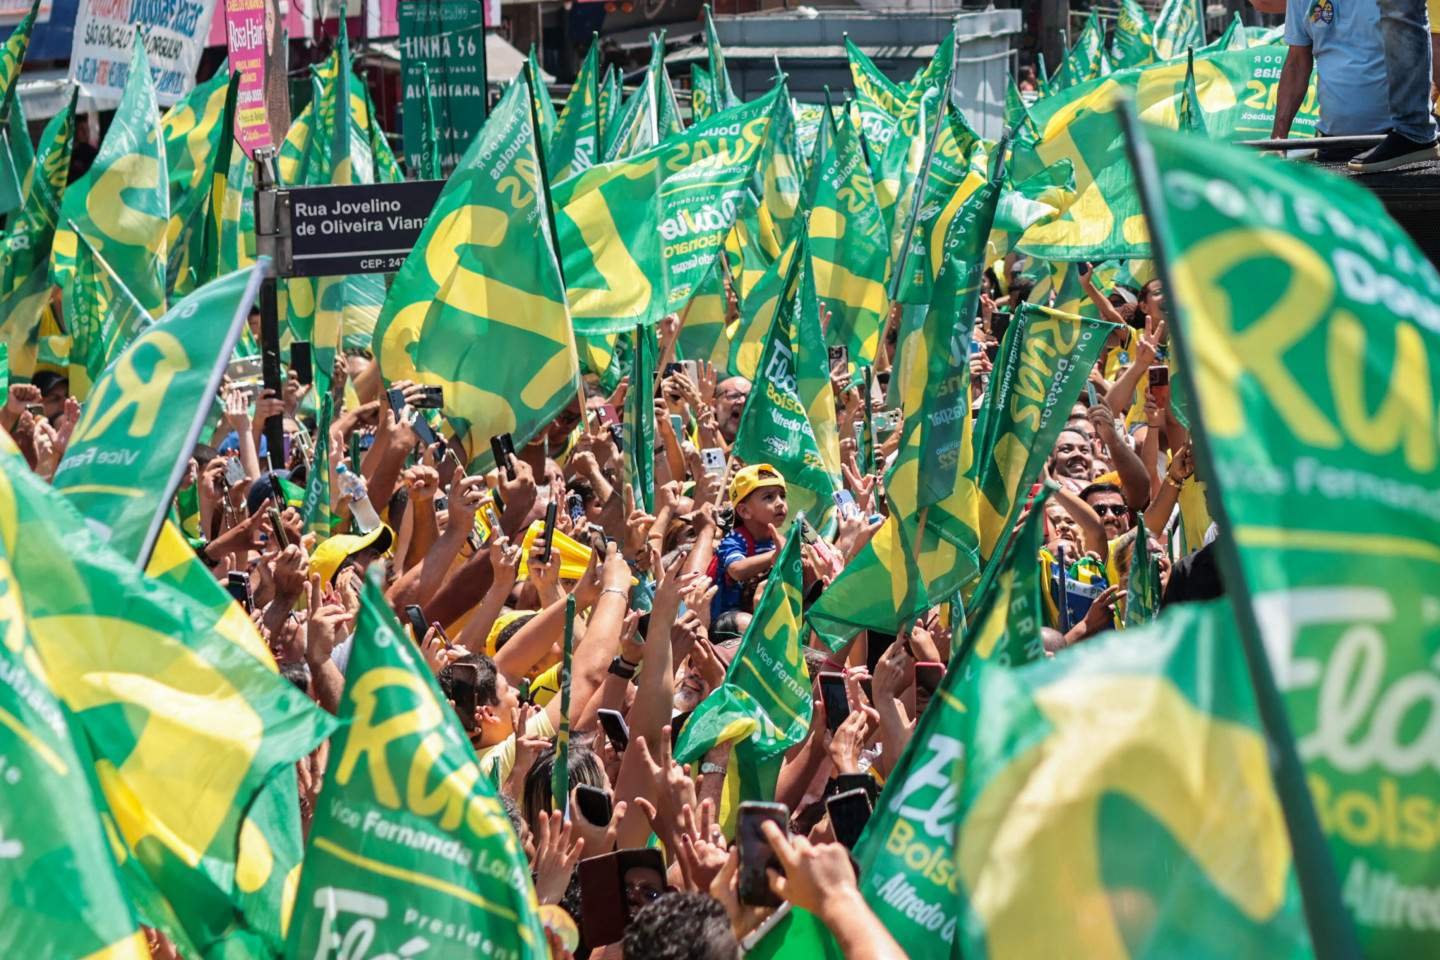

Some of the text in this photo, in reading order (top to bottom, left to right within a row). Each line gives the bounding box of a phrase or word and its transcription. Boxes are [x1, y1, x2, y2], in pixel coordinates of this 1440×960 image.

[405, 34, 477, 59] LINHA 56
[295, 199, 401, 218] Rua Jovelino
[296, 220, 316, 237] de
[320, 216, 384, 235] Oliveira
[360, 259, 386, 270] CEP:
[1010, 318, 1082, 433] Ruas
[771, 407, 802, 432] Alfredo
[756, 641, 774, 667] Vice
[361, 811, 472, 864] Fernanda
[875, 872, 944, 934] Alfredo
